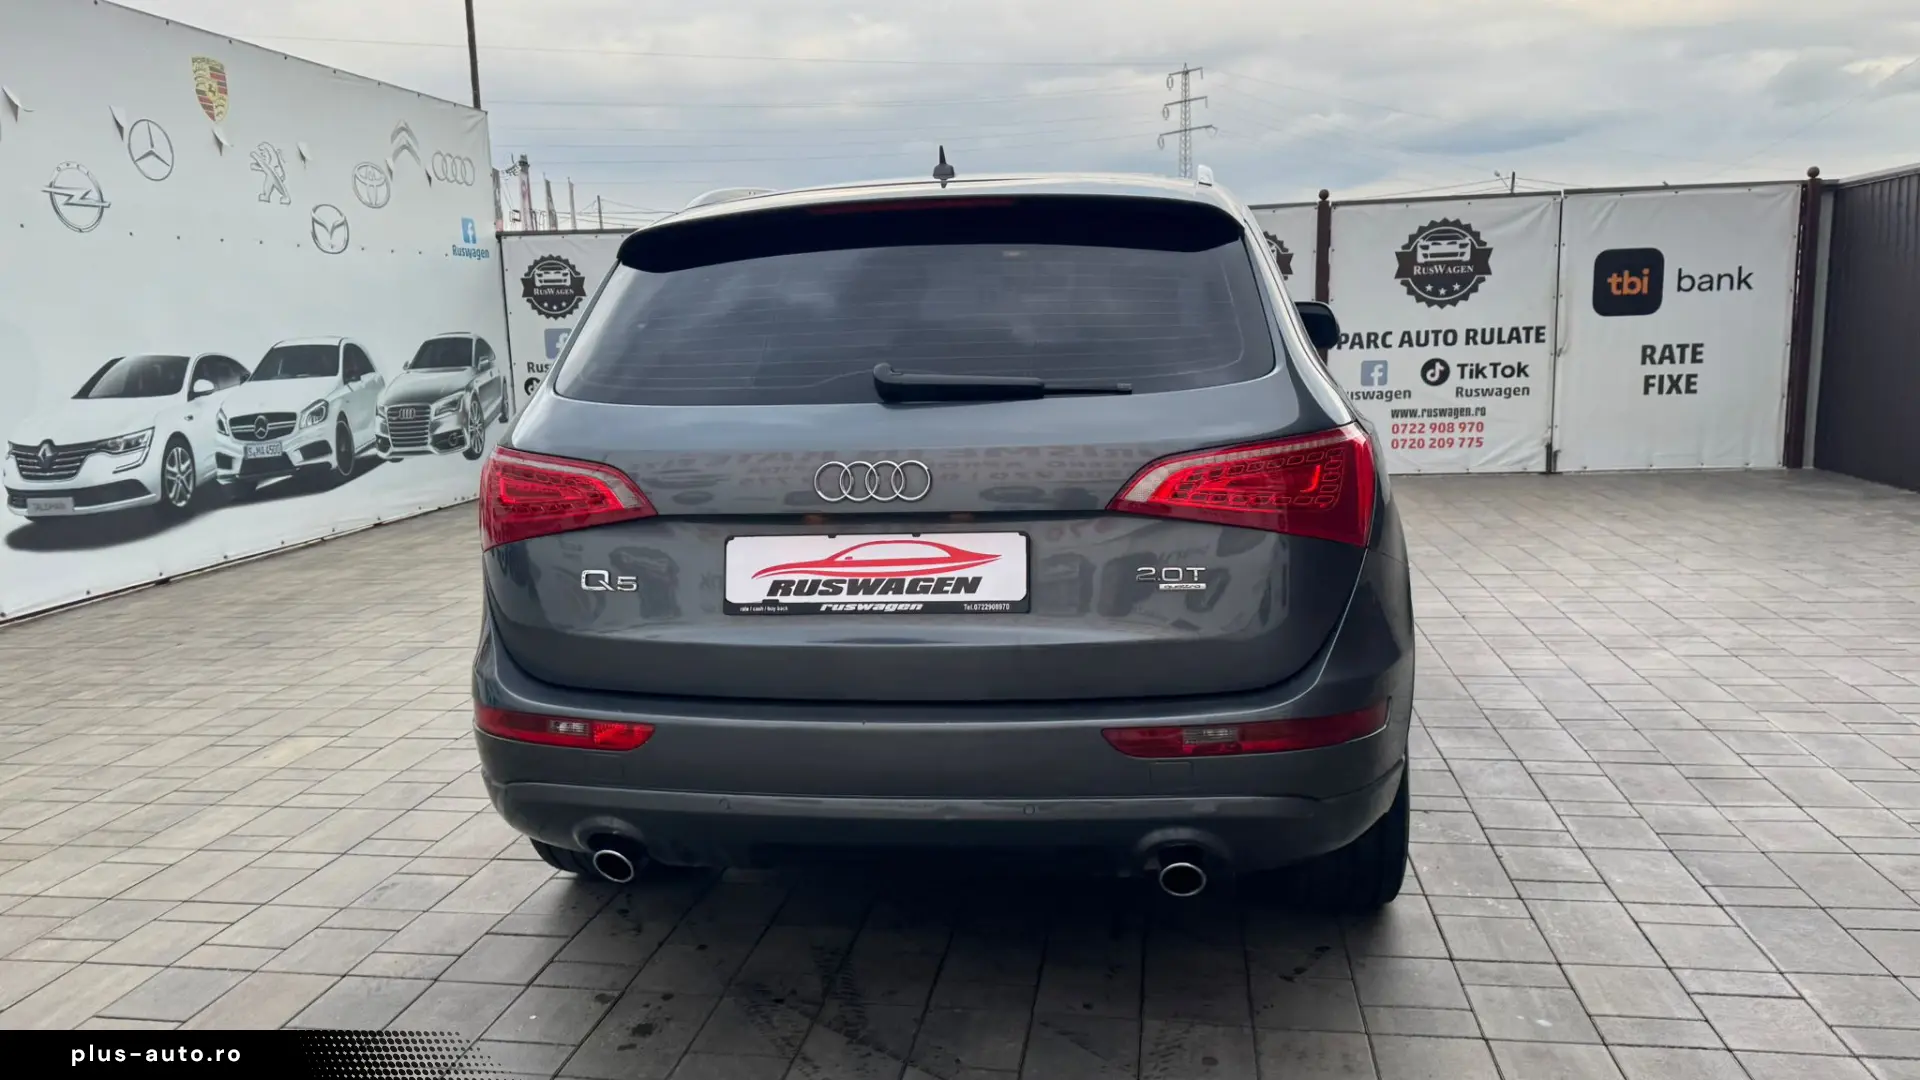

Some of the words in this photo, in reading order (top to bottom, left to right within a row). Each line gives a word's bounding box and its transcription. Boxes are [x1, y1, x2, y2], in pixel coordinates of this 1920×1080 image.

[452, 245, 490, 260] Ruswagen
[1607, 268, 1650, 296] tbi
[1676, 265, 1754, 293] bank
[1337, 331, 1393, 350] PARC
[1398, 329, 1458, 348] AUTO
[1465, 326, 1546, 346] RULATE
[1640, 343, 1705, 366] RATE
[527, 361, 551, 374] Rus
[1456, 362, 1530, 379] TikTok
[1643, 373, 1698, 396] FIXE
[1455, 386, 1530, 399] Ruswagen
[1391, 406, 1487, 420] www.ruswagen.ro
[1391, 423, 1425, 435] 0722
[1429, 422, 1455, 434] 908
[1458, 421, 1484, 433] 970
[1391, 438, 1425, 450] 0720
[1428, 437, 1454, 449] 209
[1458, 437, 1484, 448] 775
[581, 569, 638, 592] Q5
[1136, 566, 1206, 581] 2.0T
[766, 576, 983, 597] RUSWAGEN
[820, 603, 923, 612] ruswagen
